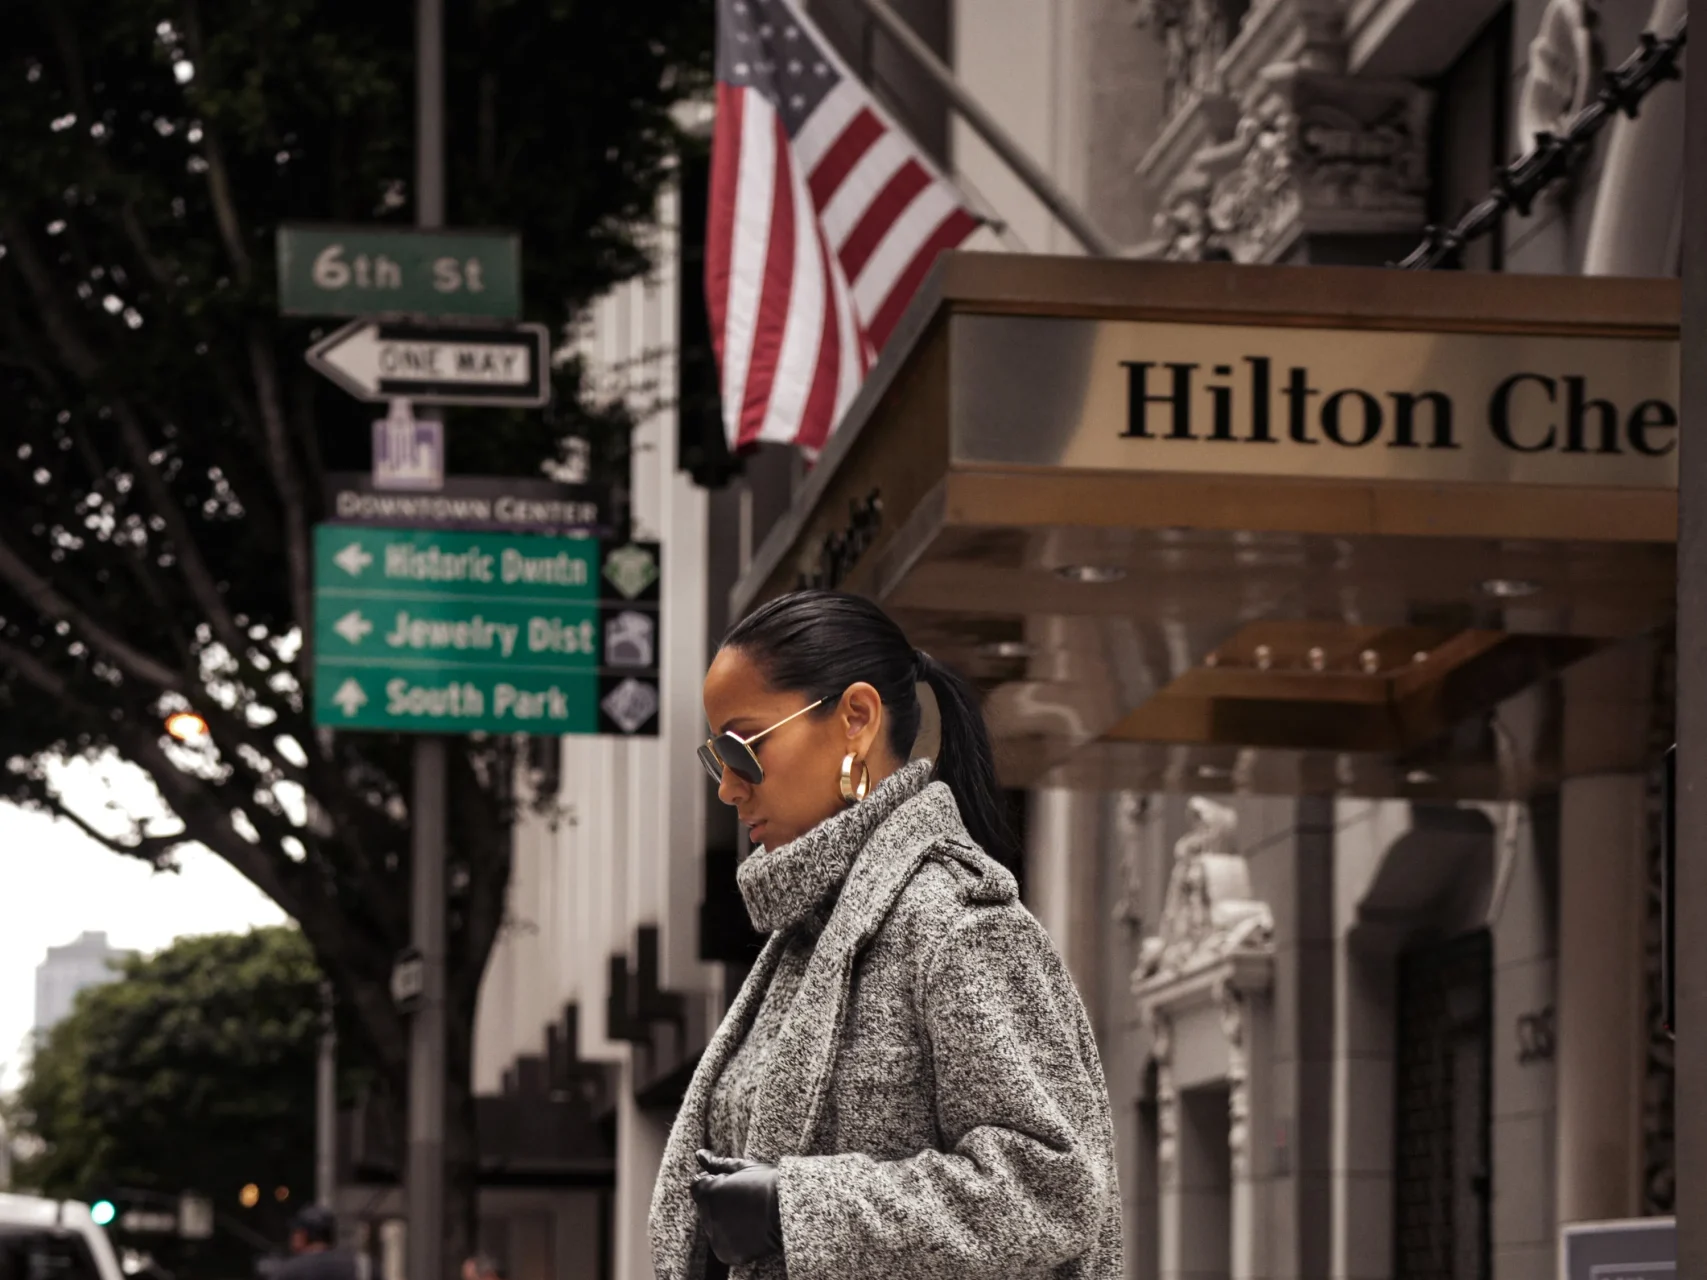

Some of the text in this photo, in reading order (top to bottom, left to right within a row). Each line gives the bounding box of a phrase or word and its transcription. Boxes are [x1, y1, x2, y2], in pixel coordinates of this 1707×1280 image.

[312, 244, 484, 293] 6th St
[378, 346, 520, 376] ONE WAY
[1118, 355, 1678, 457] Hilton Che
[384, 543, 588, 586] Historic Dwntn
[386, 610, 596, 657] Jewelry Dist
[385, 677, 569, 720] South Park
